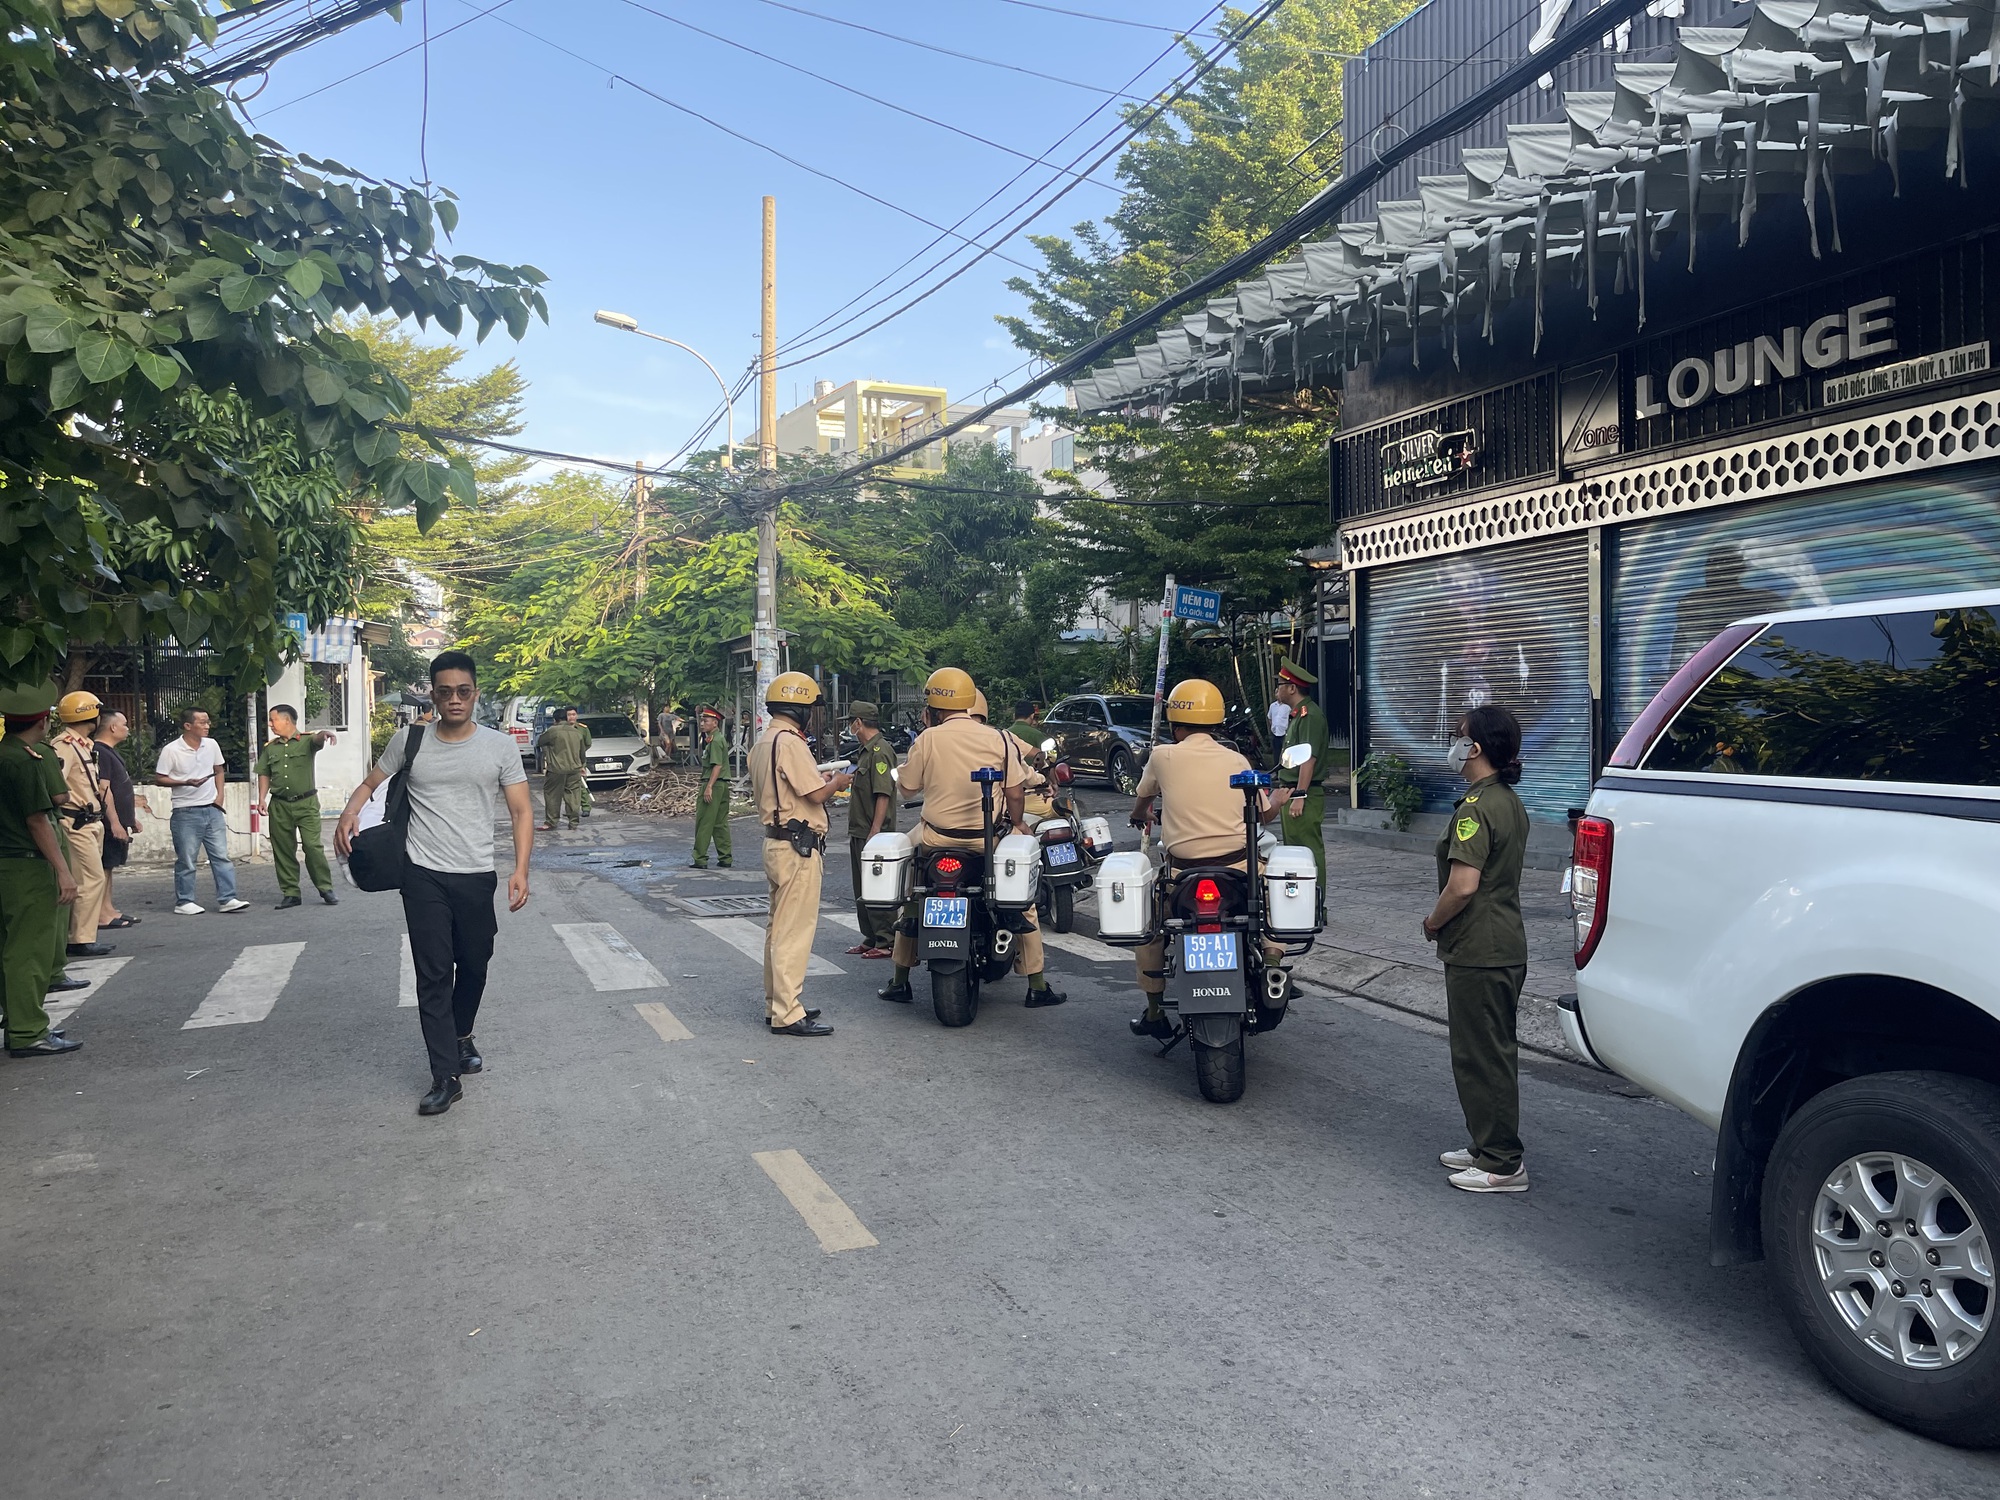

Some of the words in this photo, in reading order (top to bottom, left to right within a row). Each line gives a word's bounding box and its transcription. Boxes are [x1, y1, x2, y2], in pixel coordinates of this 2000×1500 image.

[1636, 296, 1898, 420] LOUNGE
[1827, 386, 1837, 403] 80
[1868, 373, 1891, 394] LONG,
[1893, 373, 1899, 389] P.
[1901, 362, 1917, 387] TÂN
[1938, 360, 1948, 379] Q.
[1949, 355, 1966, 376] TÂN
[1968, 342, 1986, 371] PHÚ
[1400, 434, 1435, 463] SILVER
[1182, 591, 1202, 606] HẺM
[1203, 598, 1215, 609] 80
[1179, 606, 1188, 615] LỘ
[289, 619, 301, 629] 81
[781, 686, 810, 696] CSGT
[931, 687, 955, 697] CSGT
[75, 704, 95, 713] CSGT
[931, 900, 960, 912] 59-A1
[927, 913, 963, 925] 012.43
[928, 940, 958, 948] HONDA
[1191, 935, 1228, 951] 59-A1
[1188, 952, 1233, 969] 014.67
[1192, 987, 1231, 997] HONDA
